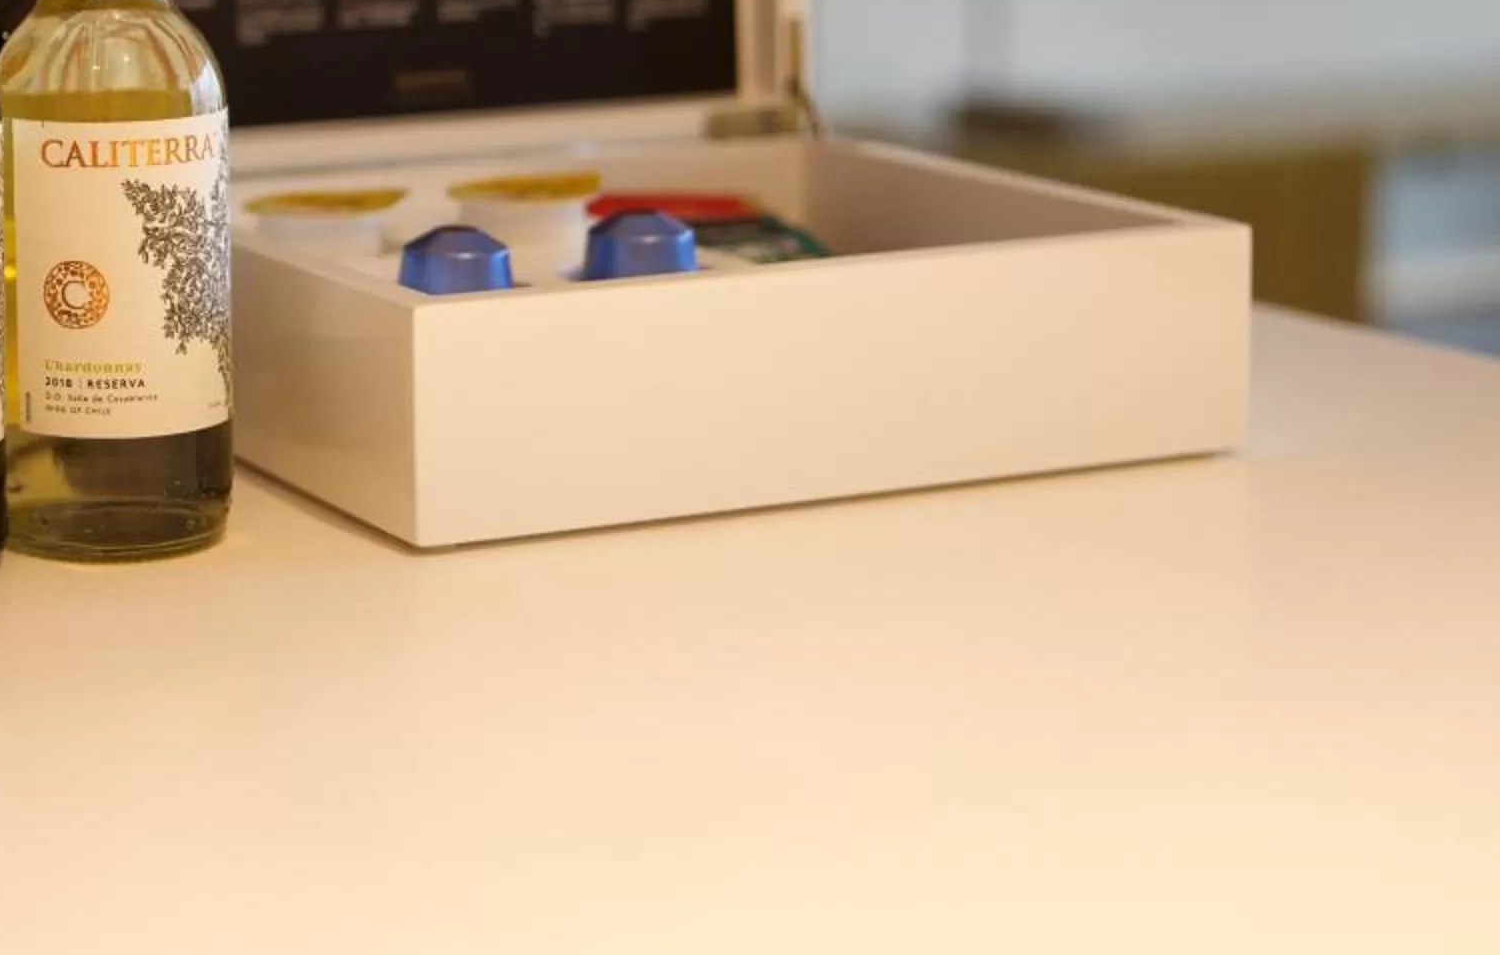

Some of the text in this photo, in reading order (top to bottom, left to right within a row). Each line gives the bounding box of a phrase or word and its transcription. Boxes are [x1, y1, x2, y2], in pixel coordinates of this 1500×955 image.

[40, 132, 216, 168] CALITERRA
[44, 359, 142, 375] Chardonnay
[45, 376, 145, 389] 2018 RESERVA
